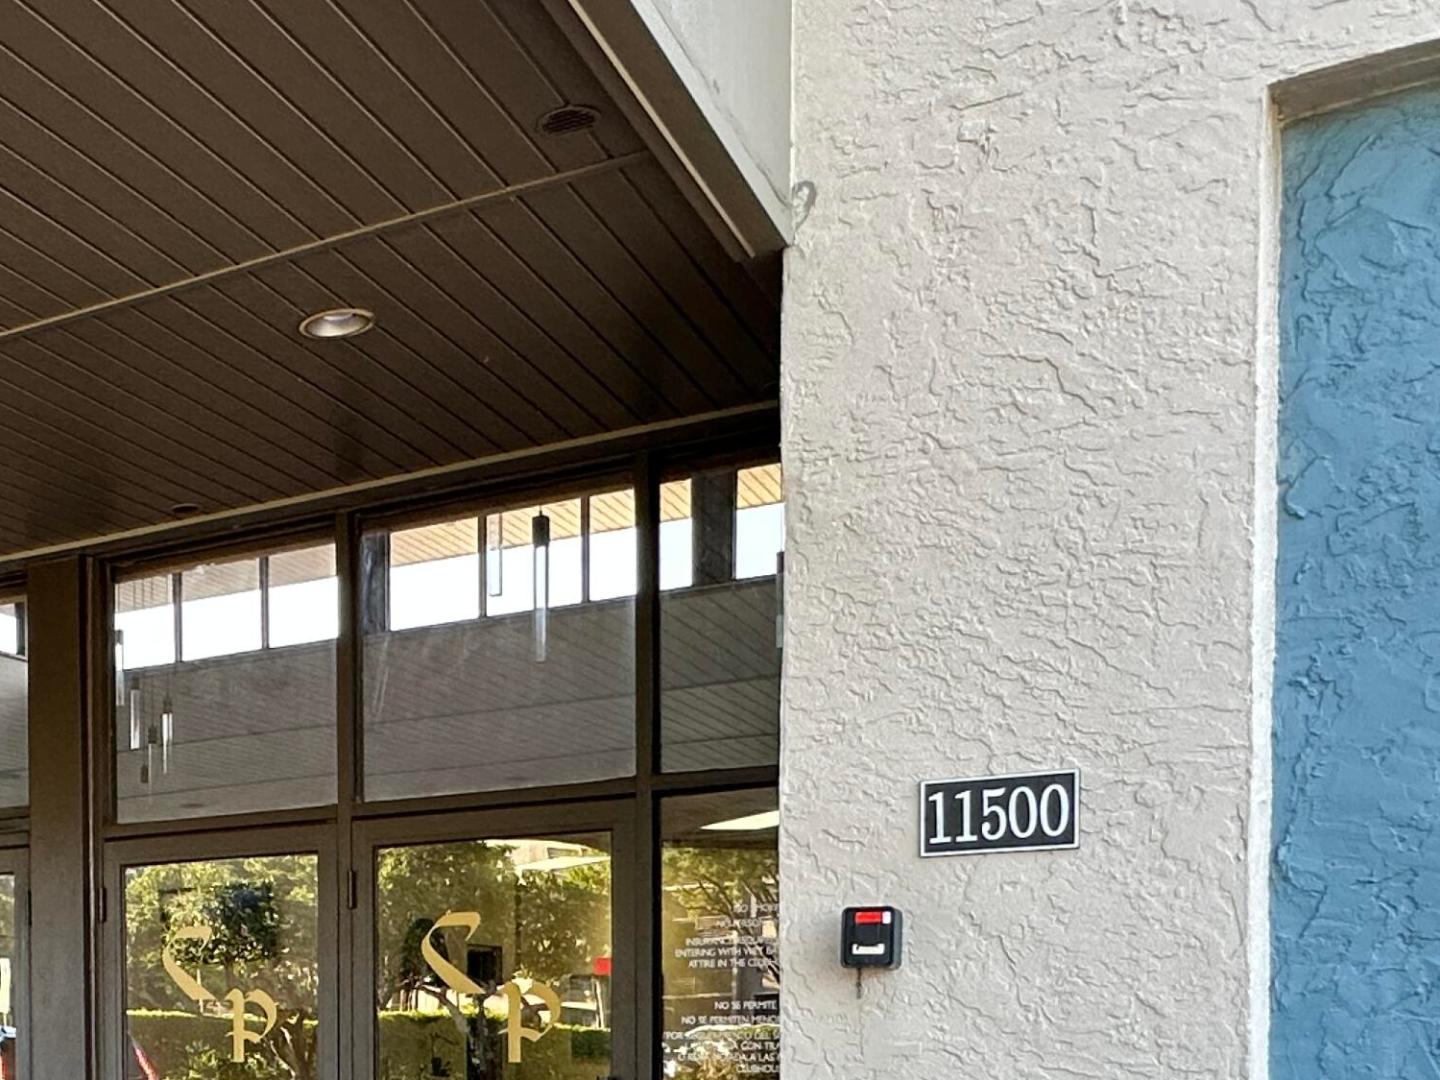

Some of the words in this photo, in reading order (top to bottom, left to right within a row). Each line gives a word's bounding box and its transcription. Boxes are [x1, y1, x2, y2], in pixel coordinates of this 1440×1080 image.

[928, 783, 1070, 845] 11500
[674, 948, 716, 958] ENTERING
[718, 948, 741, 957] WITH
[688, 959, 715, 968] ATTIRE
[717, 959, 728, 968] IN
[730, 958, 745, 967] THE
[714, 1001, 730, 1010] NO
[743, 1000, 777, 1010] PERMITE
[681, 1016, 696, 1025] NO
[709, 1015, 750, 1025] PERMITEN
[741, 1041, 761, 1050] CON
